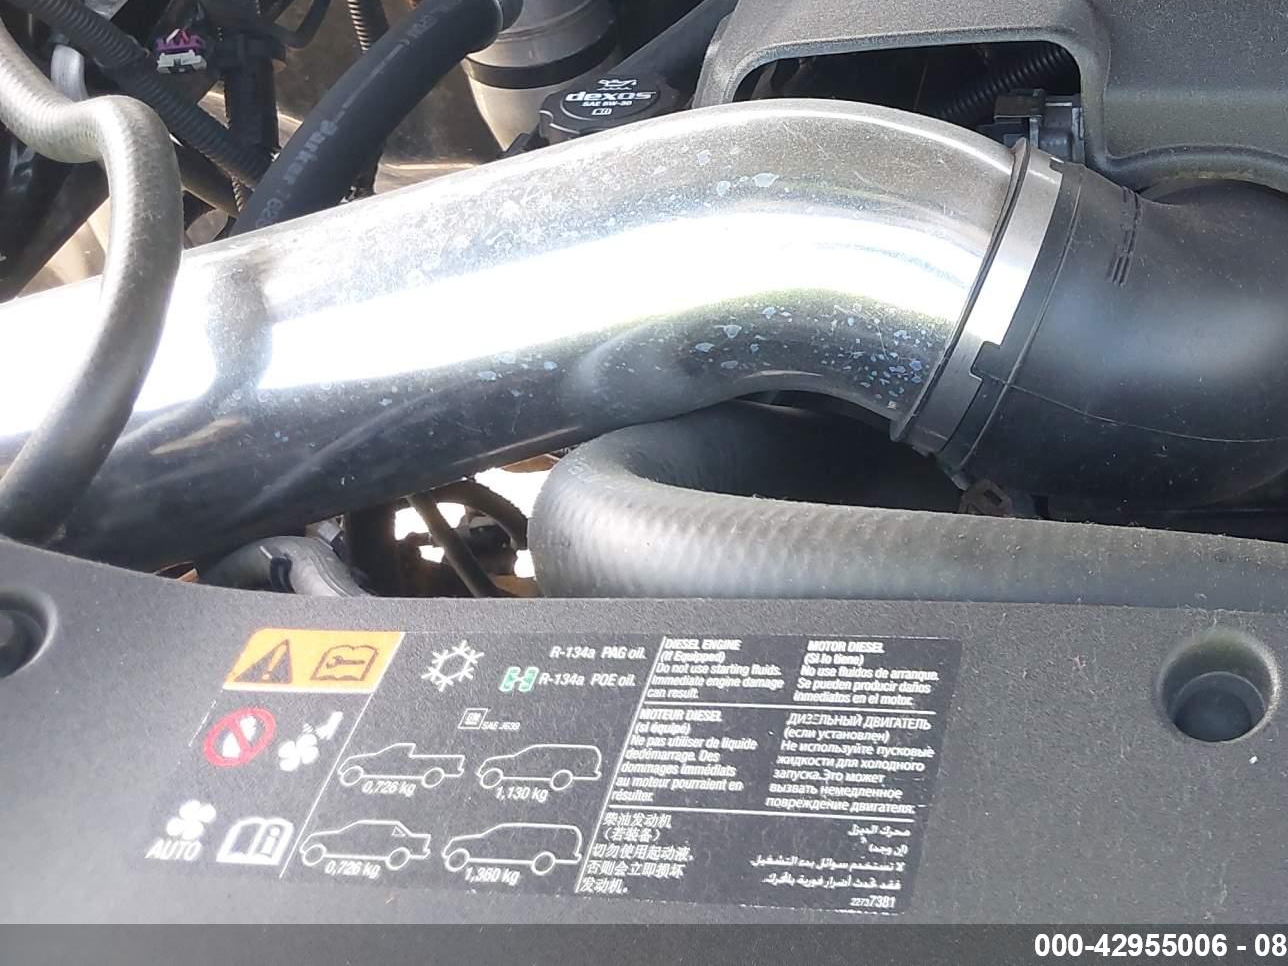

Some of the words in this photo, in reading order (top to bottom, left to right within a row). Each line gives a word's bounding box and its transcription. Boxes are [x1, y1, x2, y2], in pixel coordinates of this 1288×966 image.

[565, 91, 657, 101] dexos
[664, 638, 700, 650] DIESEL
[701, 639, 743, 650] ENGINE
[807, 640, 847, 652] MOTOR
[847, 641, 886, 653] DIESEL
[549, 646, 596, 659] R-134a
[601, 647, 627, 659] PAG
[627, 647, 647, 660] oil.
[673, 651, 726, 664] Equipped)
[804, 652, 820, 665] (Si
[821, 653, 832, 664] lo
[833, 654, 864, 667] tiene)
[655, 663, 671, 674] Do
[671, 664, 689, 674] not
[690, 665, 709, 674] use
[710, 664, 750, 677] starting
[750, 664, 782, 676] fluids.
[800, 665, 816, 677] No
[817, 667, 837, 677] use
[838, 666, 874, 678] fluidos
[874, 667, 889, 679] de
[890, 669, 940, 683] arranque.
[538, 673, 585, 685] R-134a
[590, 673, 617, 686] POE
[618, 674, 636, 687] oil.
[651, 675, 705, 687] Immediate
[705, 677, 741, 689] engine
[742, 677, 785, 691] damage
[797, 677, 812, 689] Se
[812, 679, 852, 691] pueden
[853, 680, 898, 693] producir
[646, 689, 666, 698] can
[667, 688, 699, 699] result.
[793, 690, 851, 703] inmediatos
[852, 694, 867, 704] en
[868, 693, 879, 704] el
[880, 695, 913, 706] motor.
[639, 708, 685, 721] MOTEUR
[685, 710, 723, 722] DIESEL
[786, 712, 863, 727] ДИЗЕЛЬНЫЙ
[863, 715, 932, 730] ДВИГАТЕЛЬ
[630, 734, 646, 746] Ne
[646, 737, 667, 747] pas
[667, 736, 705, 748] utiliser
[705, 737, 721, 749] de
[721, 738, 758, 751] liquide
[784, 726, 816, 739] (если
[817, 730, 890, 744] установлен)
[698, 750, 721, 762] Des
[781, 740, 798, 751] Не
[799, 742, 875, 756] используйте
[876, 746, 935, 759] пусковые
[621, 762, 679, 776] dommages
[776, 755, 835, 767] жидкости
[836, 758, 859, 769] для
[860, 759, 925, 772] холодного
[615, 777, 630, 787] au
[631, 776, 671, 788] moteur
[671, 778, 727, 791] pourraient
[728, 780, 744, 791] en
[845, 773, 886, 783] может
[361, 781, 398, 794] 0,726
[399, 782, 417, 797] kg
[496, 786, 530, 801] 1,130
[531, 787, 549, 803] kg
[769, 783, 818, 794] вызвать
[820, 785, 903, 799] немедленное
[765, 796, 849, 811] повреждение
[603, 812, 672, 829] 柴油发动机
[144, 838, 202, 861] AUTO
[324, 862, 363, 875] 0,726
[364, 862, 382, 879] kg
[587, 859, 686, 879] 否则会立即损坏
[501, 869, 521, 886] kg
